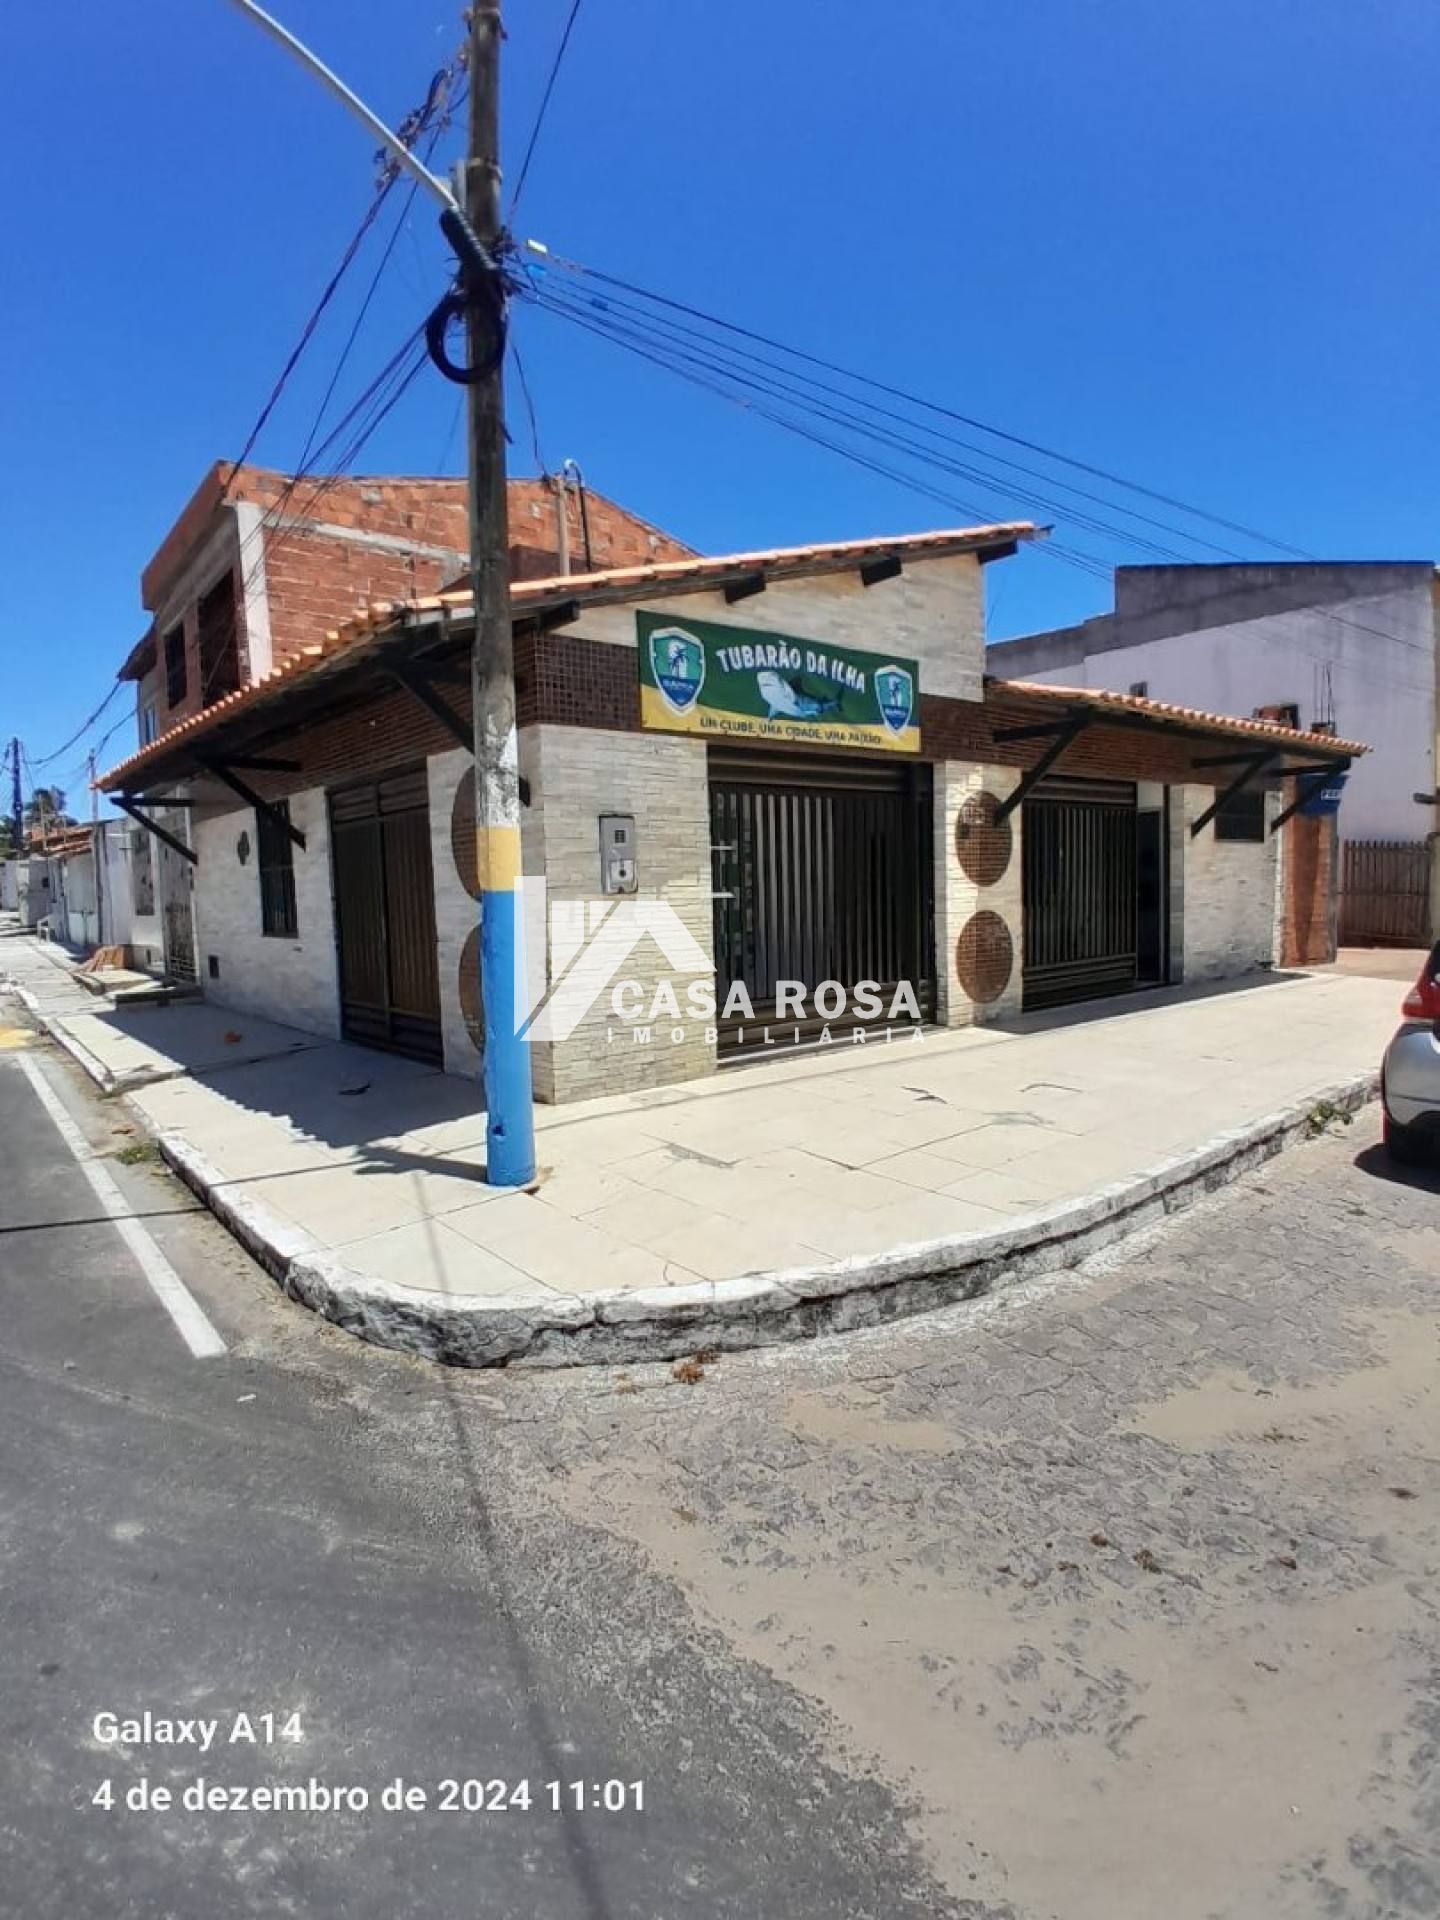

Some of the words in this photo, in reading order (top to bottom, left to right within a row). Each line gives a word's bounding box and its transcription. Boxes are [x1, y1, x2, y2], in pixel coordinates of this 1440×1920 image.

[716, 640, 801, 673] TUBARÃO
[806, 650, 828, 678] DA
[831, 658, 865, 694] ILHA
[758, 722, 783, 736] UMA
